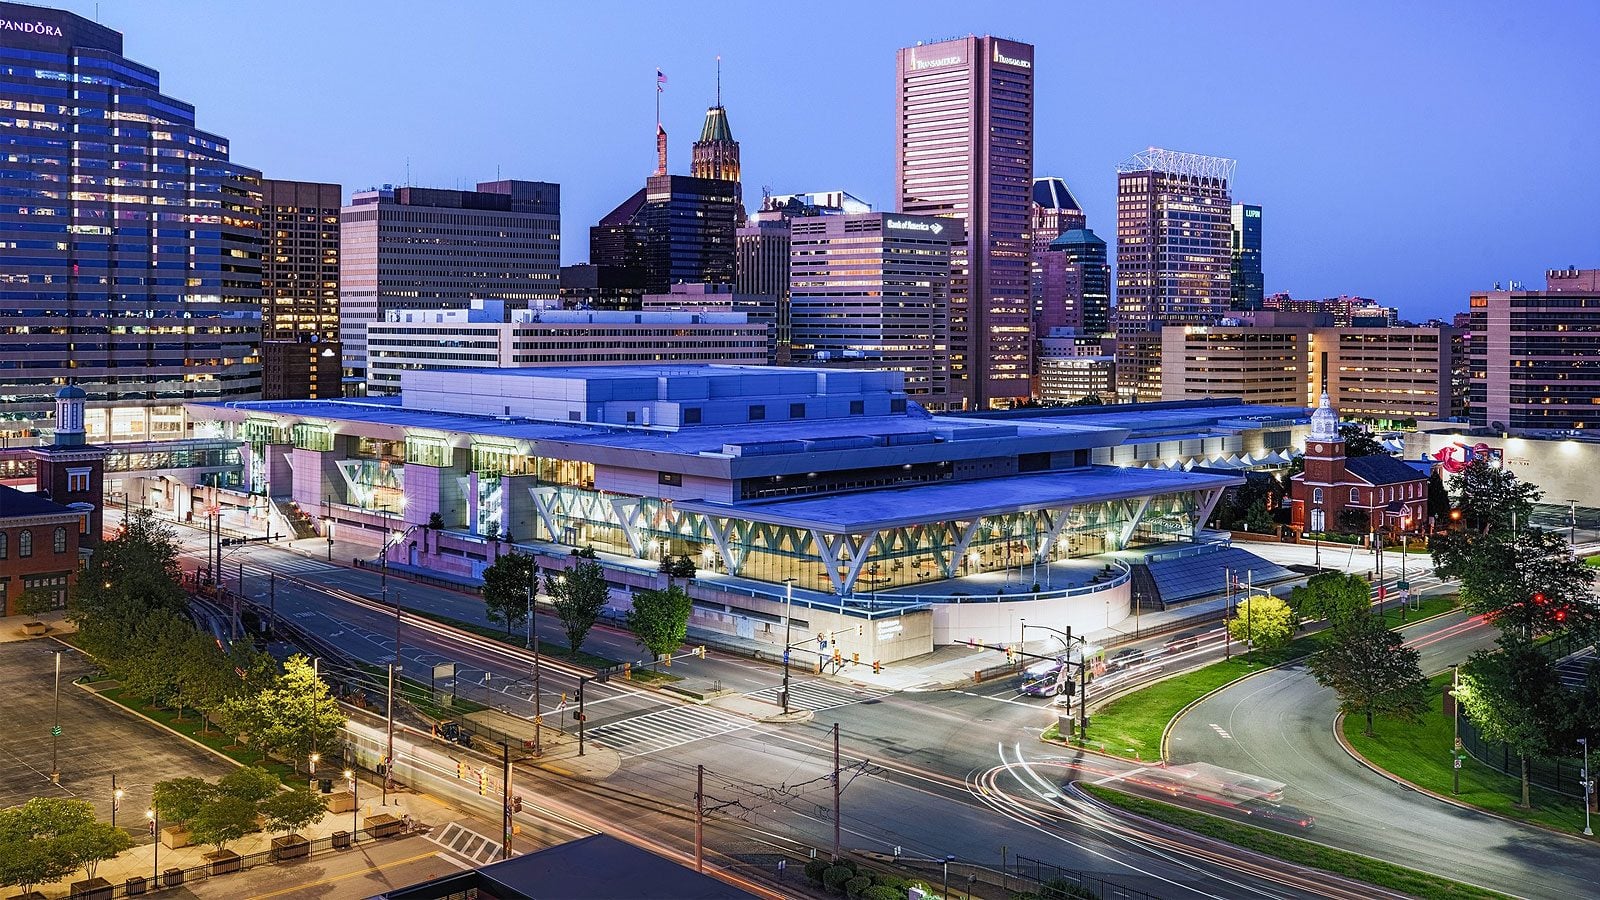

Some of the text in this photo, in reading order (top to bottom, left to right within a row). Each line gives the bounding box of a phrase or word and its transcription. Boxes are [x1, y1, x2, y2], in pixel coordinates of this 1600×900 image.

[1245, 209, 1261, 218] LUPIN
[887, 219, 930, 231] Bank of America
